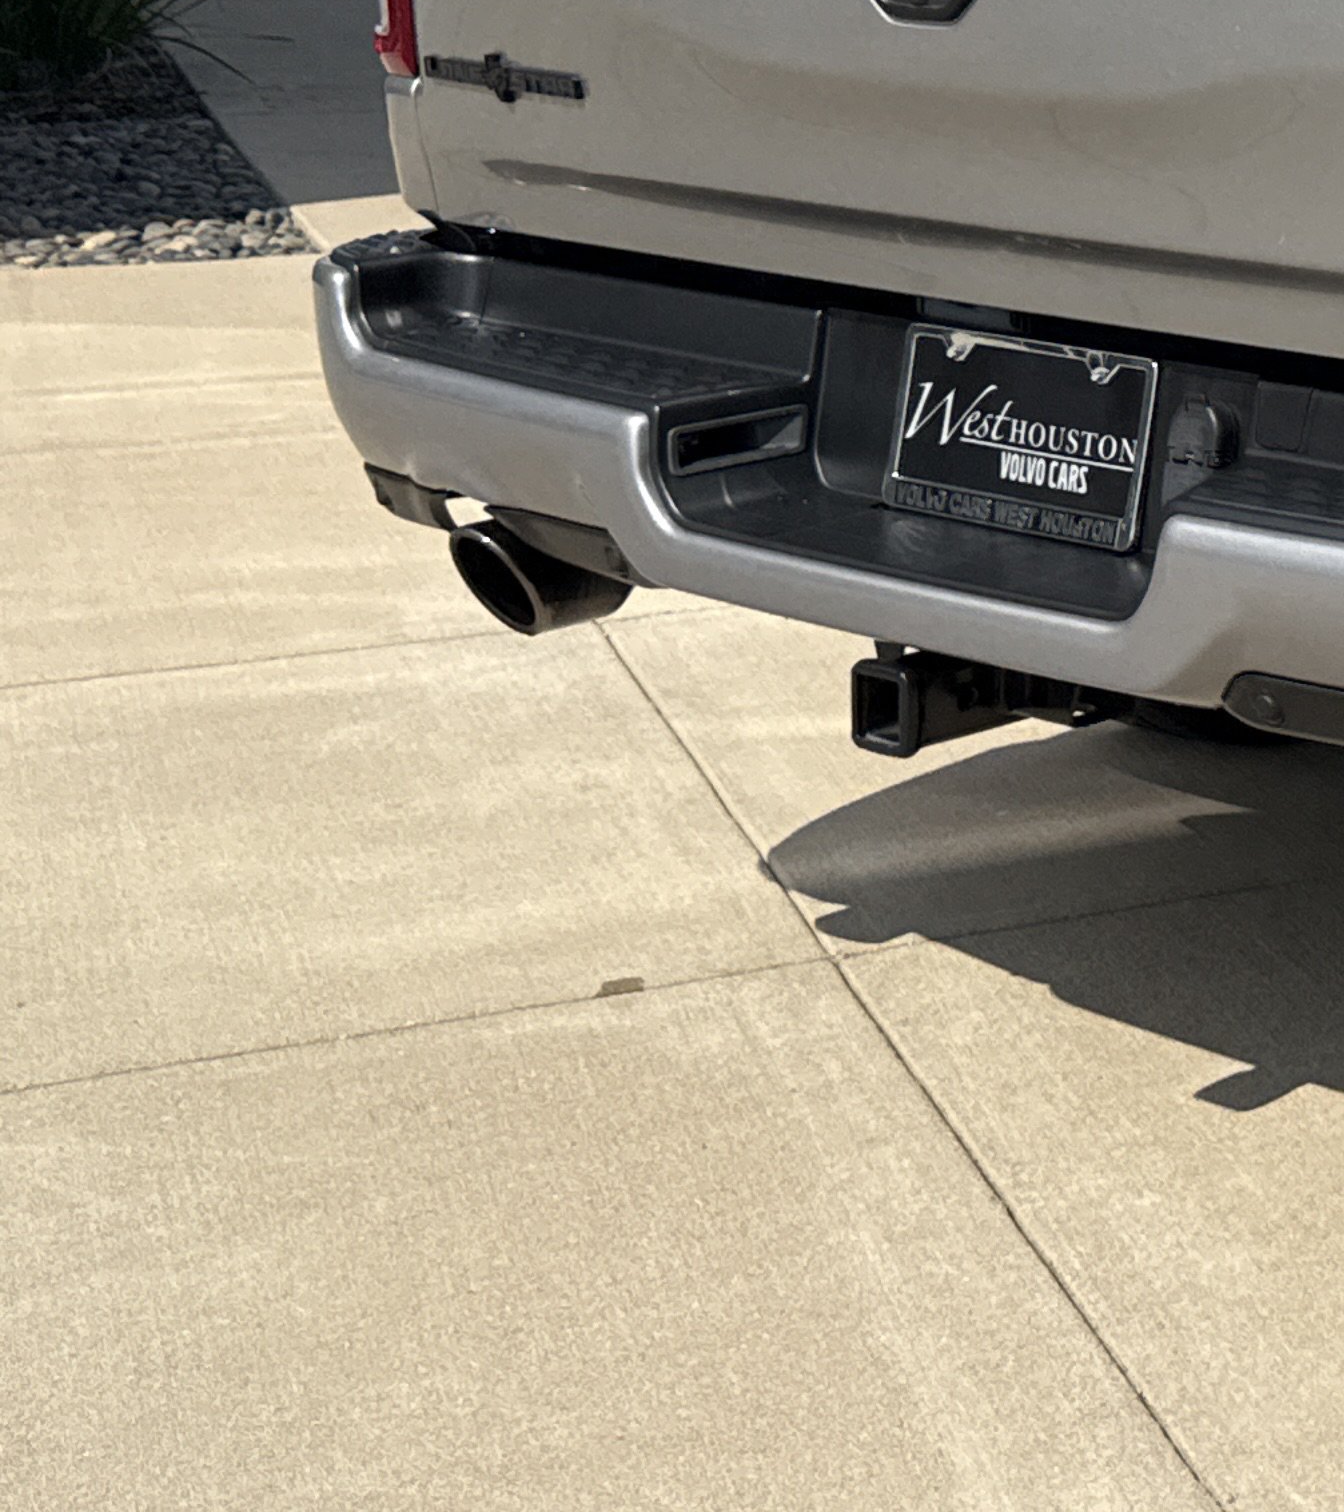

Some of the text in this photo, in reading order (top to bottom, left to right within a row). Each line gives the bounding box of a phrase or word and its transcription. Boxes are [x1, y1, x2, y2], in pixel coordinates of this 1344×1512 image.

[905, 382, 1138, 465] West HOUSTON
[1000, 451, 1089, 495] VOLVO CARS
[895, 482, 1117, 545] VOLVO CARS WEST HOUSTON
